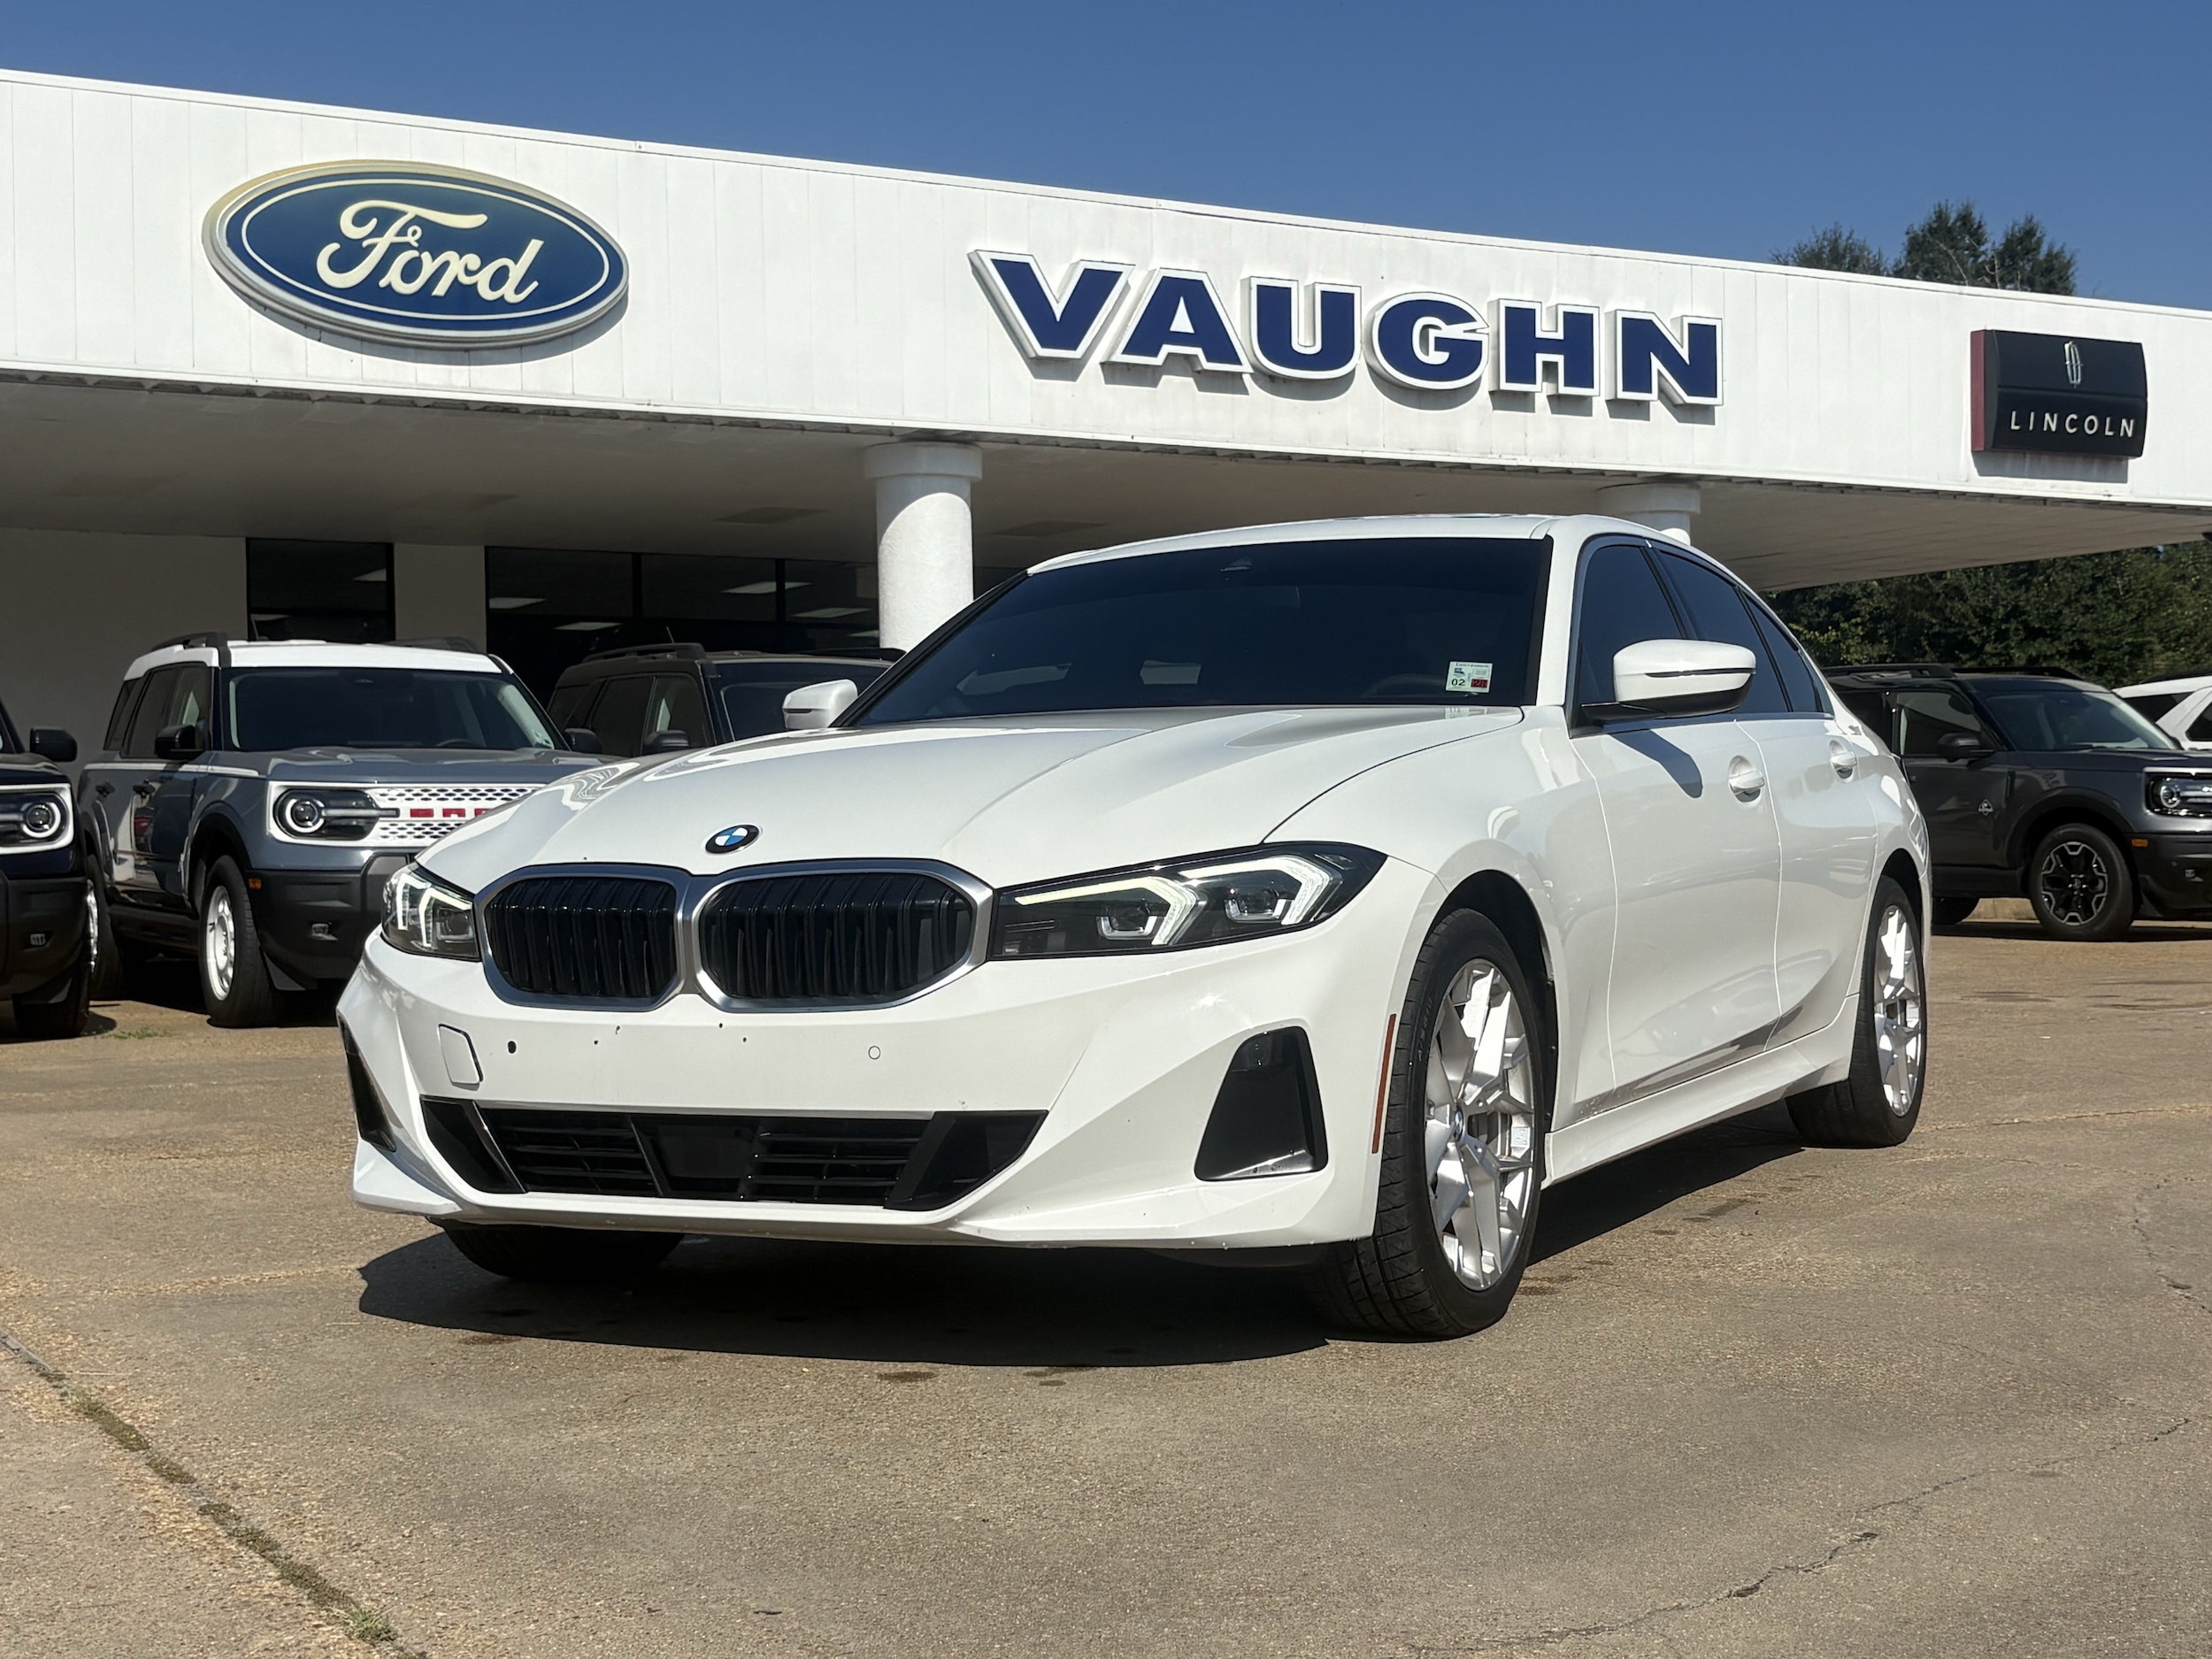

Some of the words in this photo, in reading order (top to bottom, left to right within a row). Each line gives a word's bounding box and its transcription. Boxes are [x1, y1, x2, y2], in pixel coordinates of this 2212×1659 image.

[317, 199, 544, 303] Ford
[976, 251, 1723, 405] VAUGHN
[2010, 411, 2134, 437] LINCOLN
